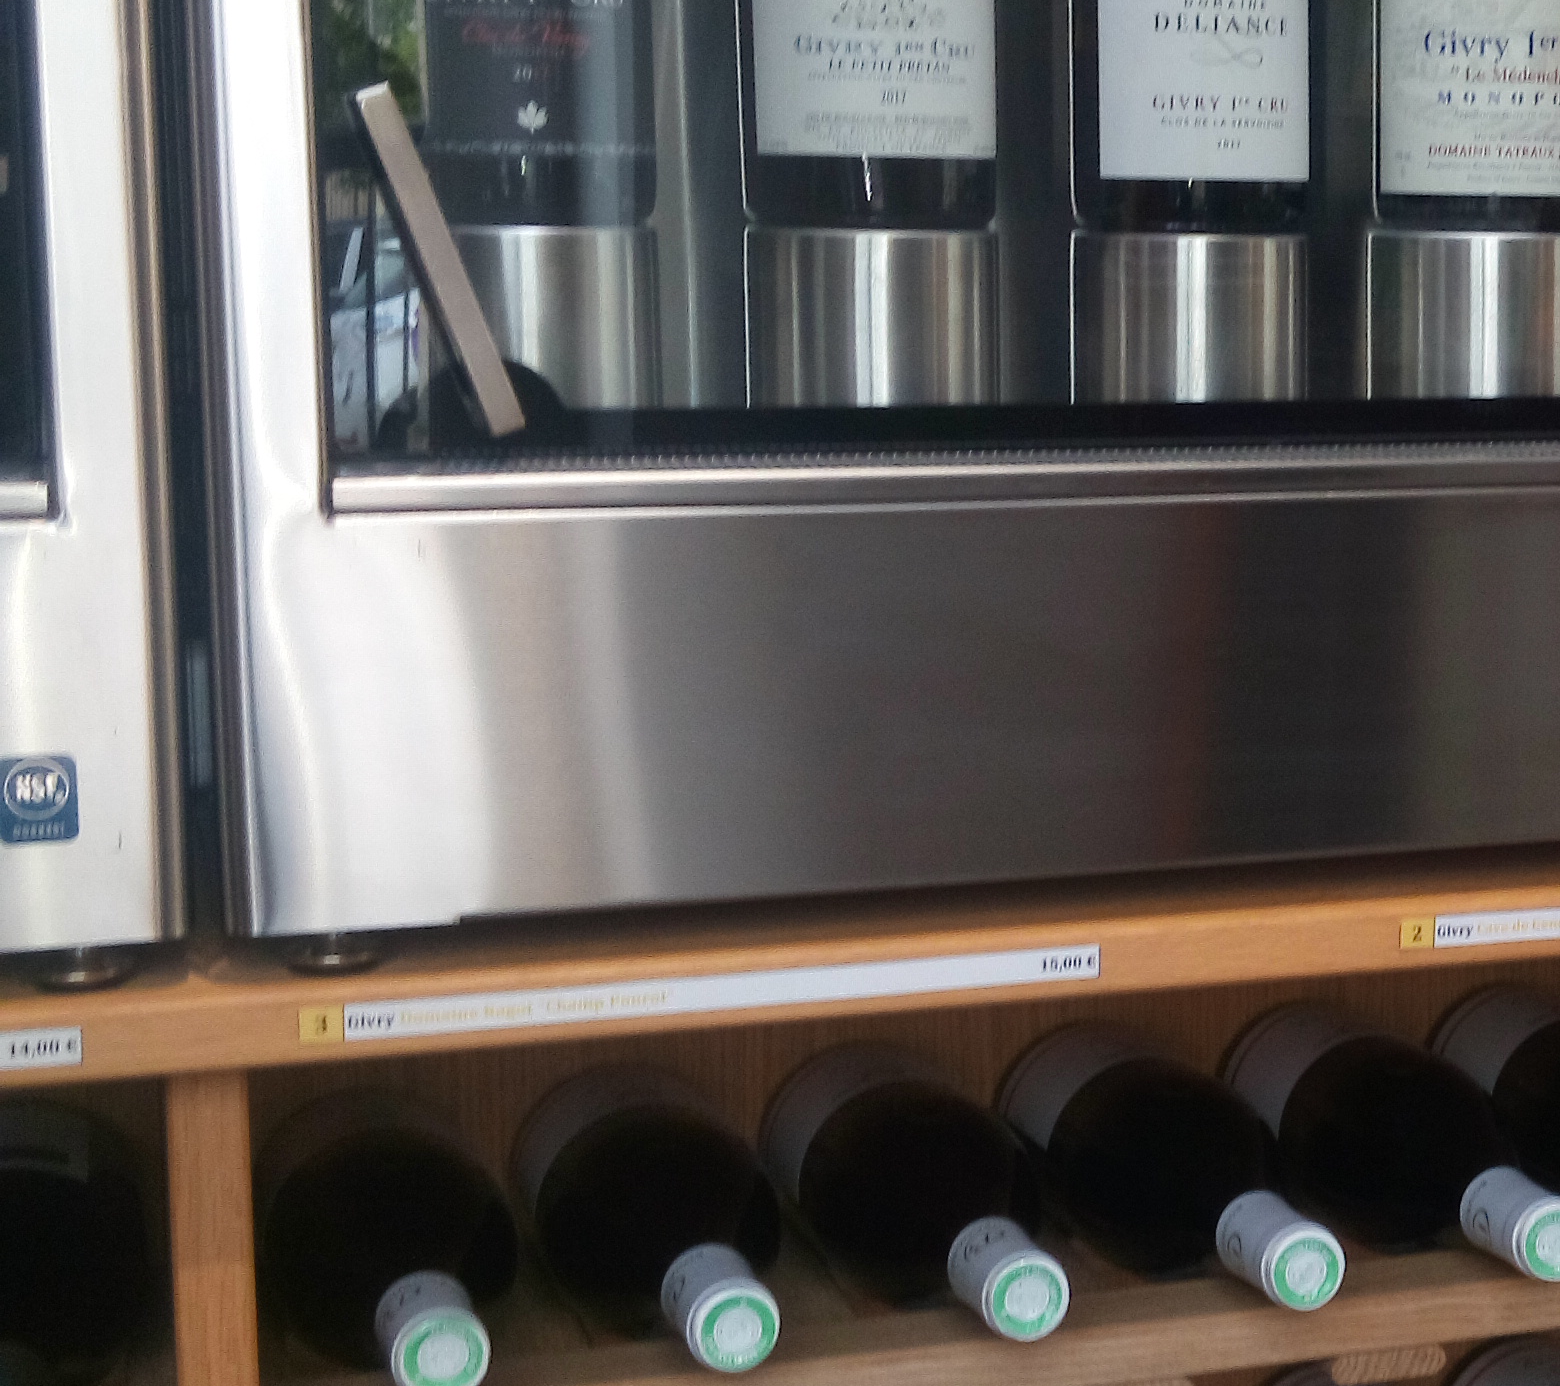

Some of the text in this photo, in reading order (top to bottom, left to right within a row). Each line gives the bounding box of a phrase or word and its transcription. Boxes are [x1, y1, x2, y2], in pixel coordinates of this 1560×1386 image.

[1423, 28, 1510, 64] Givry
[1153, 94, 1220, 113] GIVRY
[16, 773, 59, 804] NSF
[1437, 923, 1473, 940] Givry
